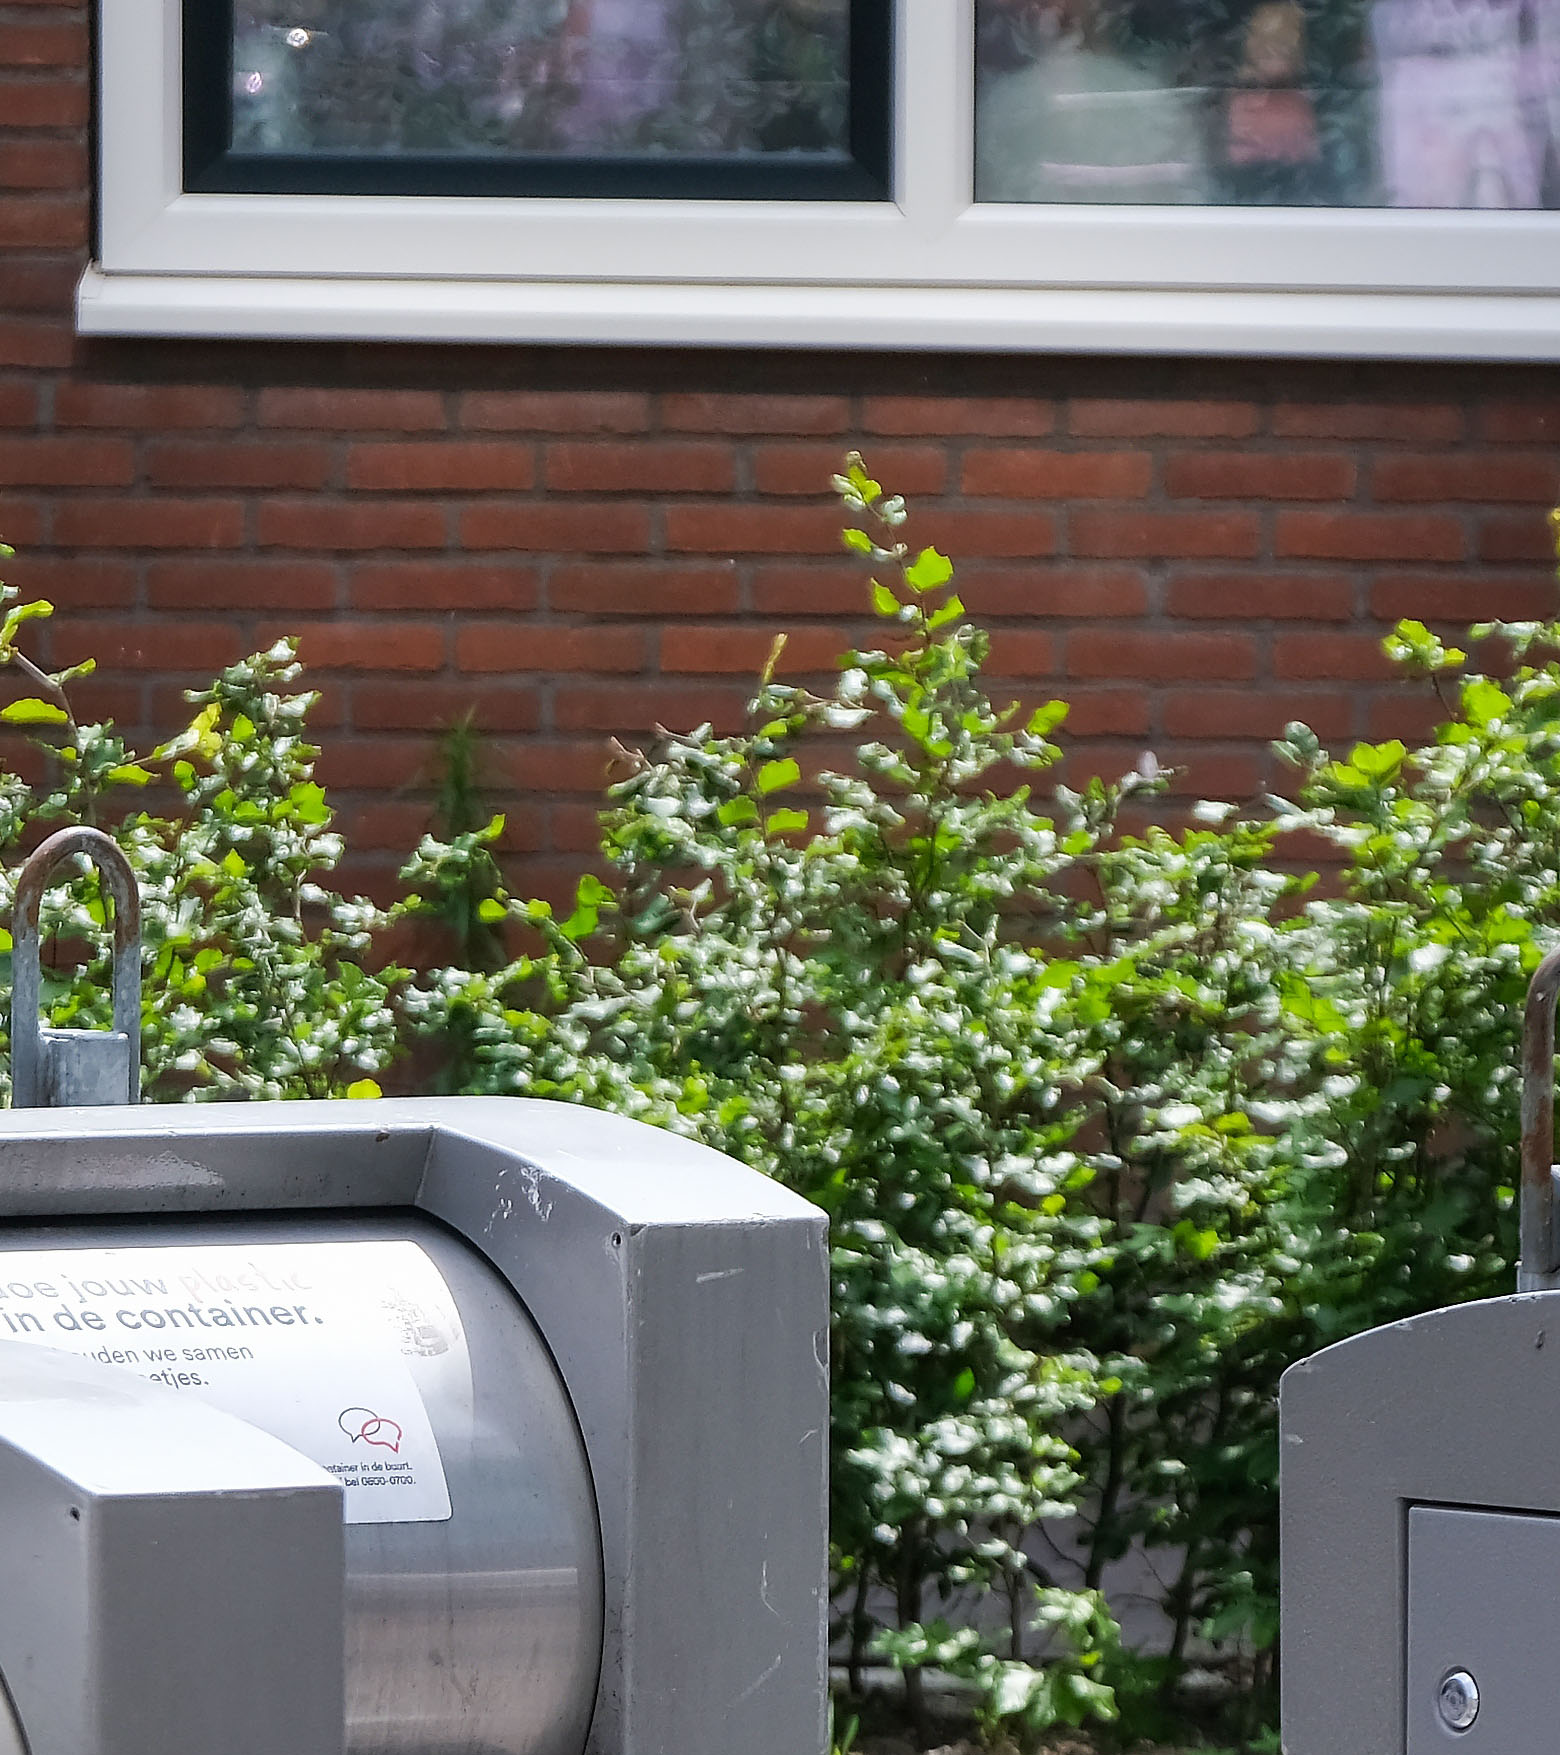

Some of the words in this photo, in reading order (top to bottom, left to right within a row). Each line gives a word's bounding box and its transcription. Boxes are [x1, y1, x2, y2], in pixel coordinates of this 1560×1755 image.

[67, 1273, 169, 1304] jouw
[180, 1262, 313, 1304] plastic
[2, 1303, 45, 1334] in
[53, 1302, 106, 1332] de
[116, 1299, 324, 1331] container.
[143, 1344, 178, 1363] we
[181, 1342, 254, 1362] samen
[140, 1367, 209, 1389] etjes.
